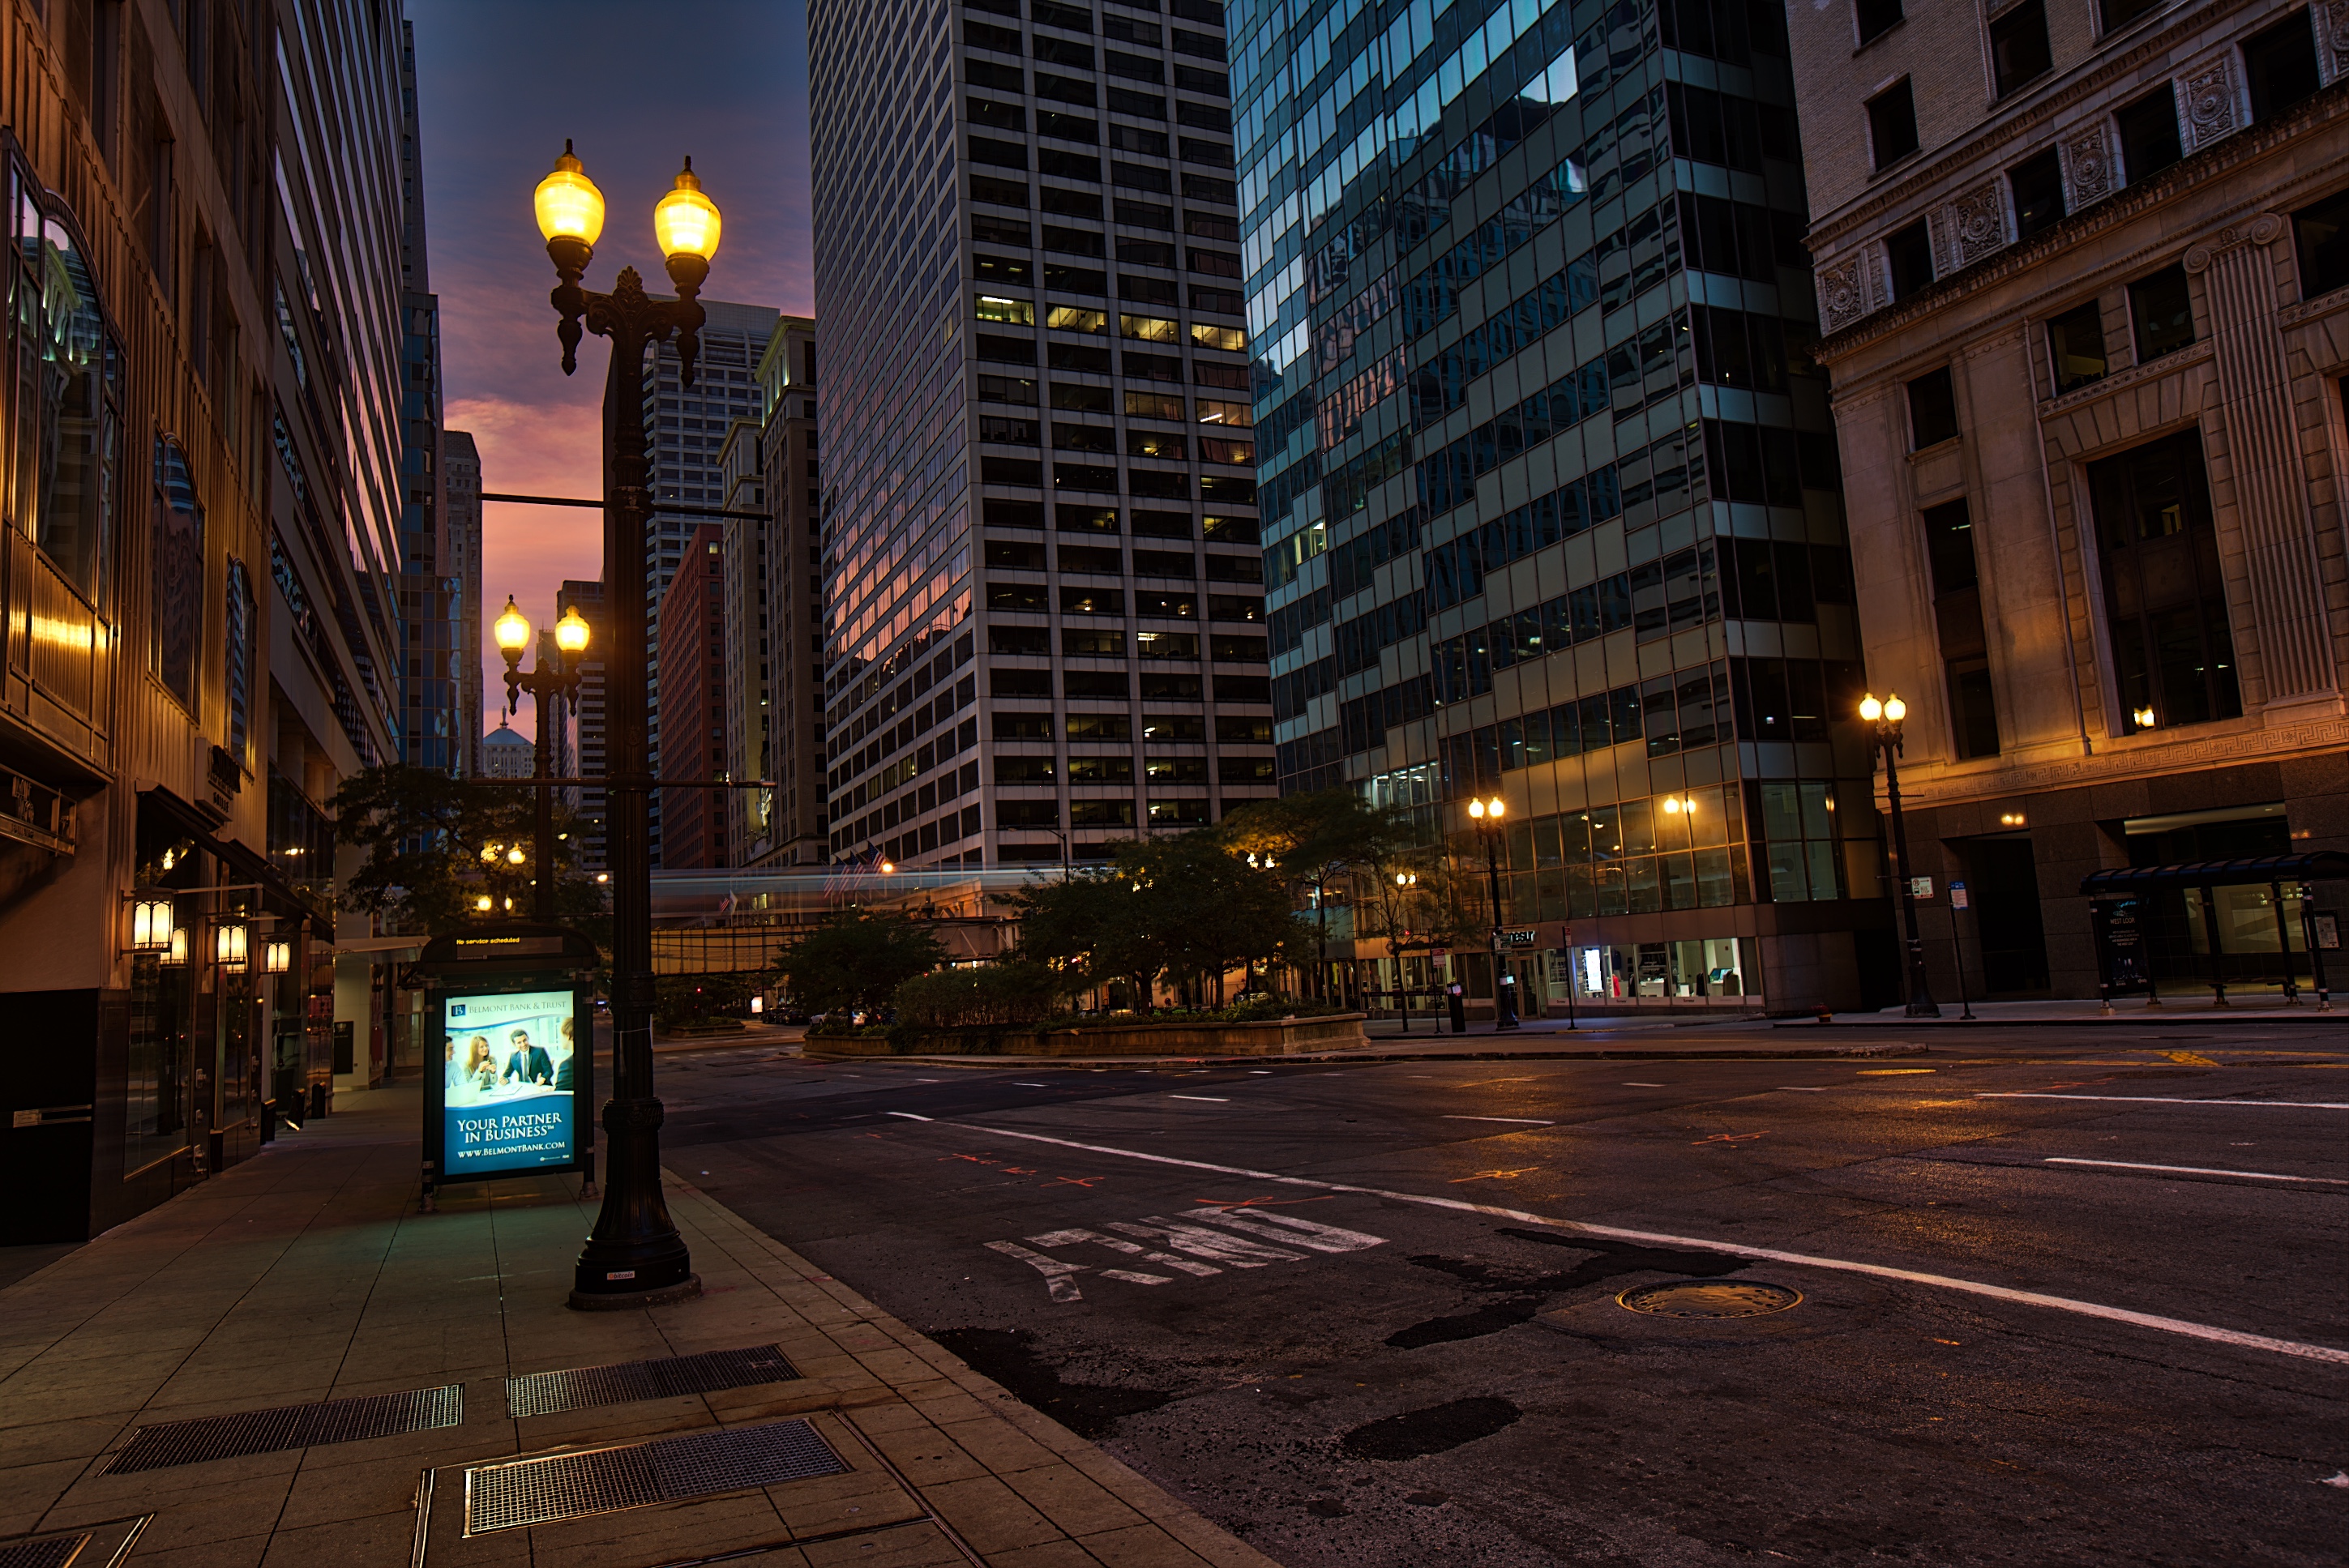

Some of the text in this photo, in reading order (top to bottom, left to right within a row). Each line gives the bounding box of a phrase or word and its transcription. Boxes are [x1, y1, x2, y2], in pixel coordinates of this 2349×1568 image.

[455, 1006, 464, 1015] B
[469, 1005, 508, 1014] BELMONT
[510, 1003, 532, 1011] BANK
[541, 1001, 567, 1009] TRUST
[457, 1112, 563, 1132] YOUR PARTNER
[464, 1131, 481, 1143] IN
[457, 1141, 566, 1159] WWW.BELMONTBANK.COM
